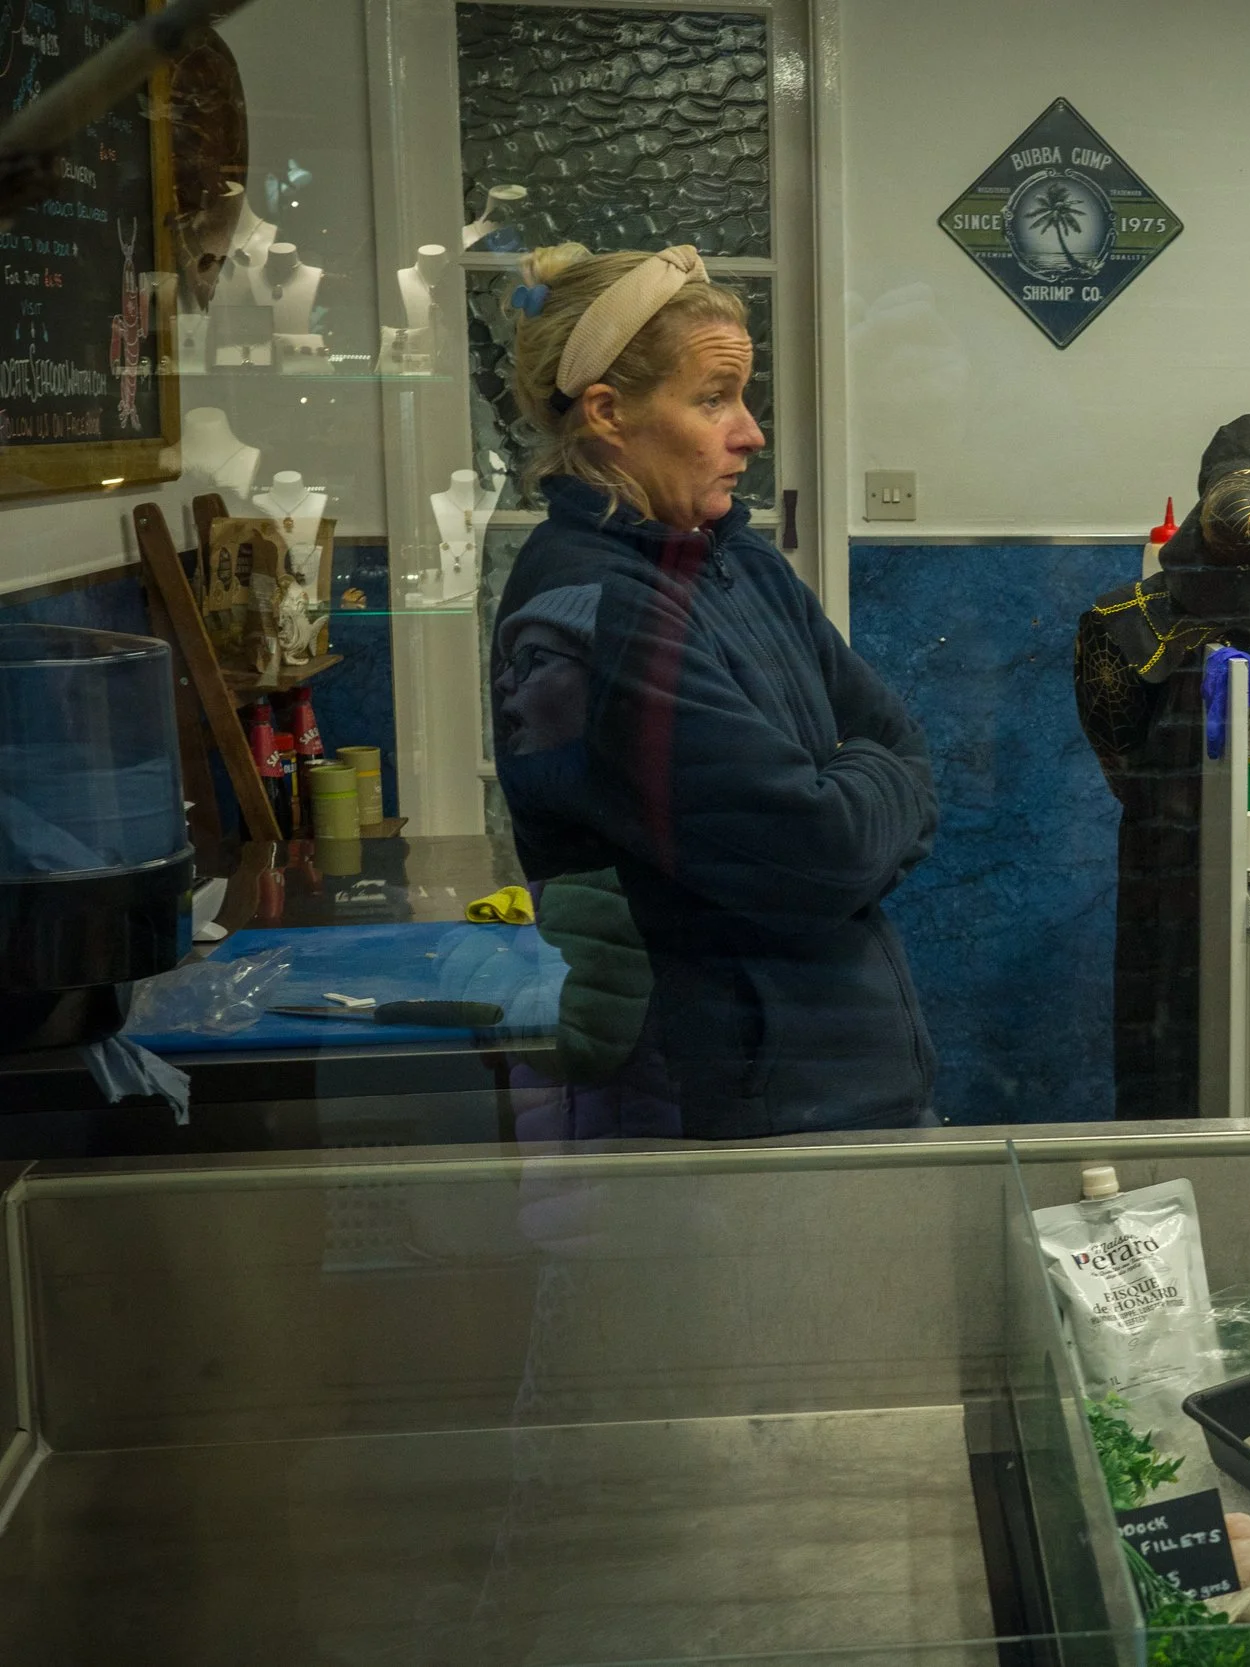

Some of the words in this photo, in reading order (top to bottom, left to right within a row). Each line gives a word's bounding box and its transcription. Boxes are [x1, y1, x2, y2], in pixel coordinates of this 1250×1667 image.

[1010, 146, 1061, 172] BUBBA
[1071, 147, 1113, 171] GUMP
[953, 213, 1001, 231] SINCE
[1120, 217, 1167, 234] 1975
[1023, 285, 1074, 302] SHRIMP
[1093, 1303, 1109, 1314] de
[1114, 1286, 1177, 1312] HOMARD
[1141, 1529, 1221, 1555] FILLETS
